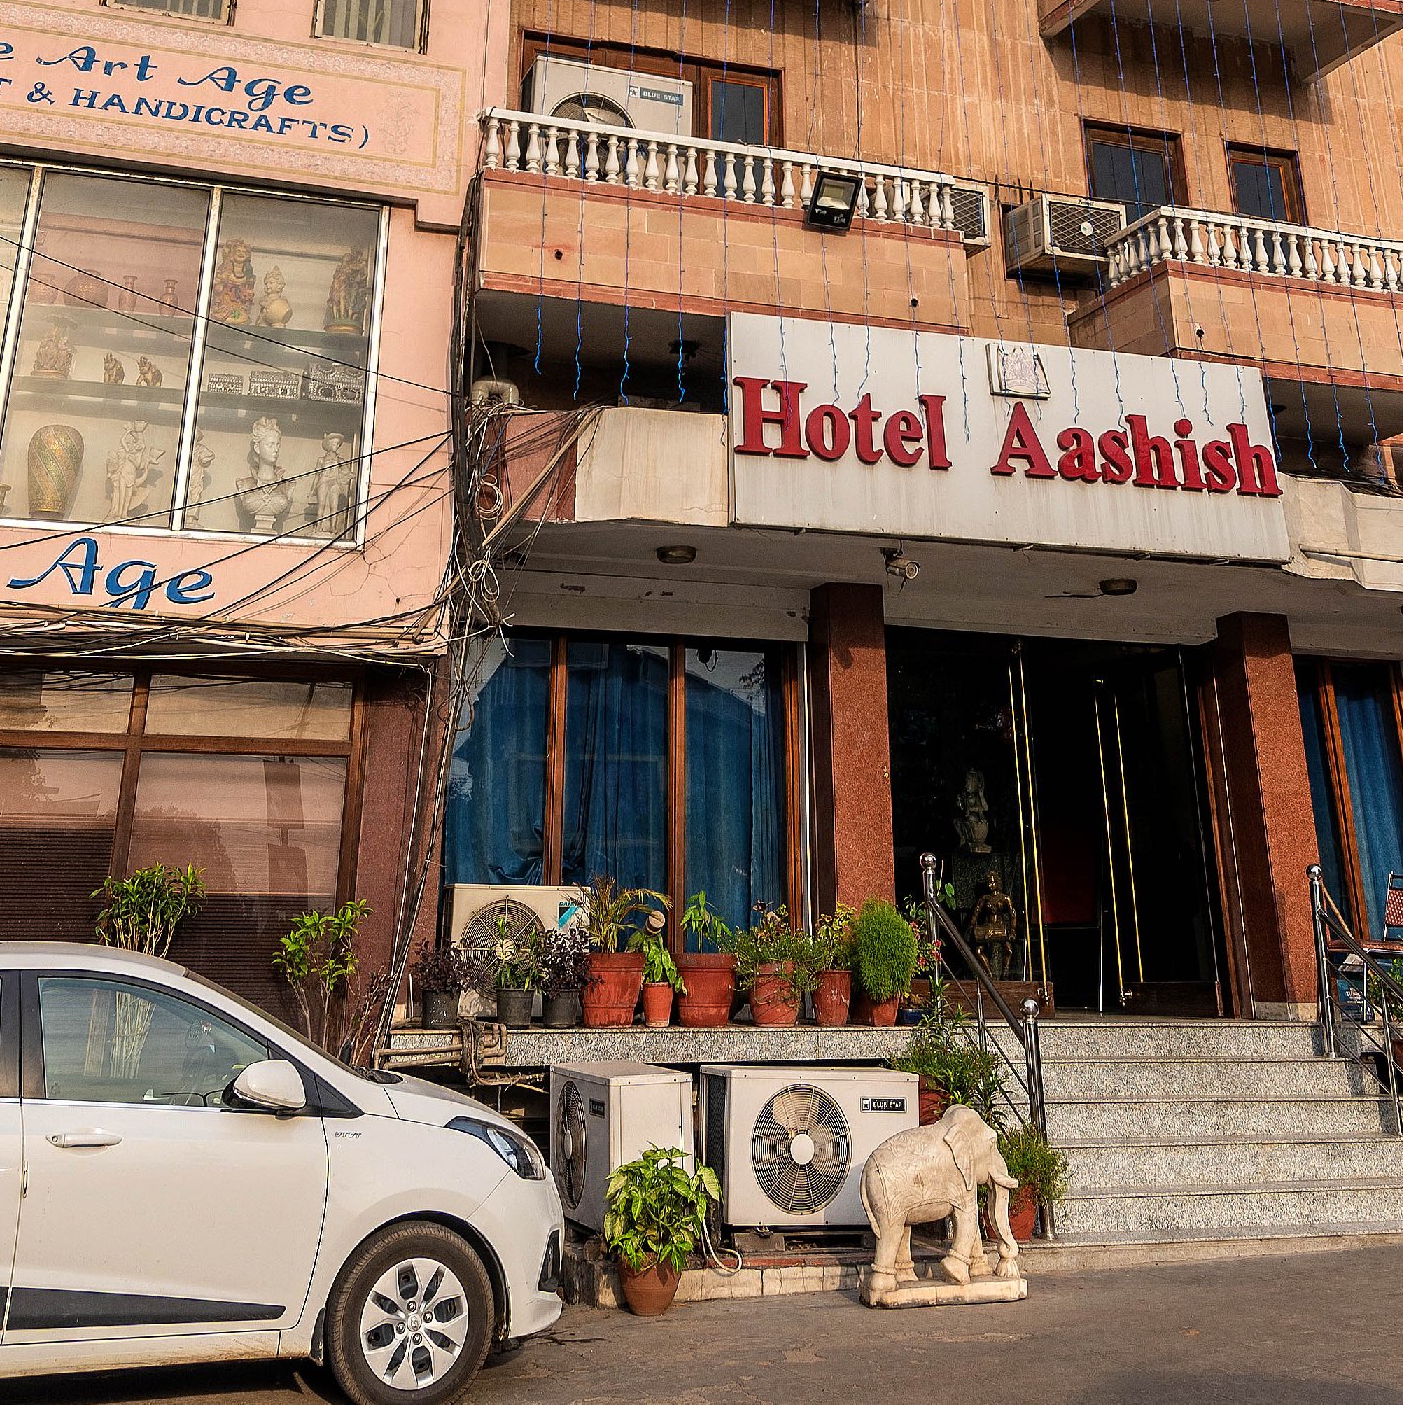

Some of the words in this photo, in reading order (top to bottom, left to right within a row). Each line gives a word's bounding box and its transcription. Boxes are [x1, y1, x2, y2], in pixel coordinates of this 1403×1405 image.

[36, 44, 158, 82] Art
[178, 65, 314, 110] Age
[26, 80, 55, 105] &
[71, 87, 370, 150] HANDICRAFTS)
[733, 376, 953, 470] Hotel
[990, 400, 1284, 498] Aashish
[7, 537, 215, 612] Age
